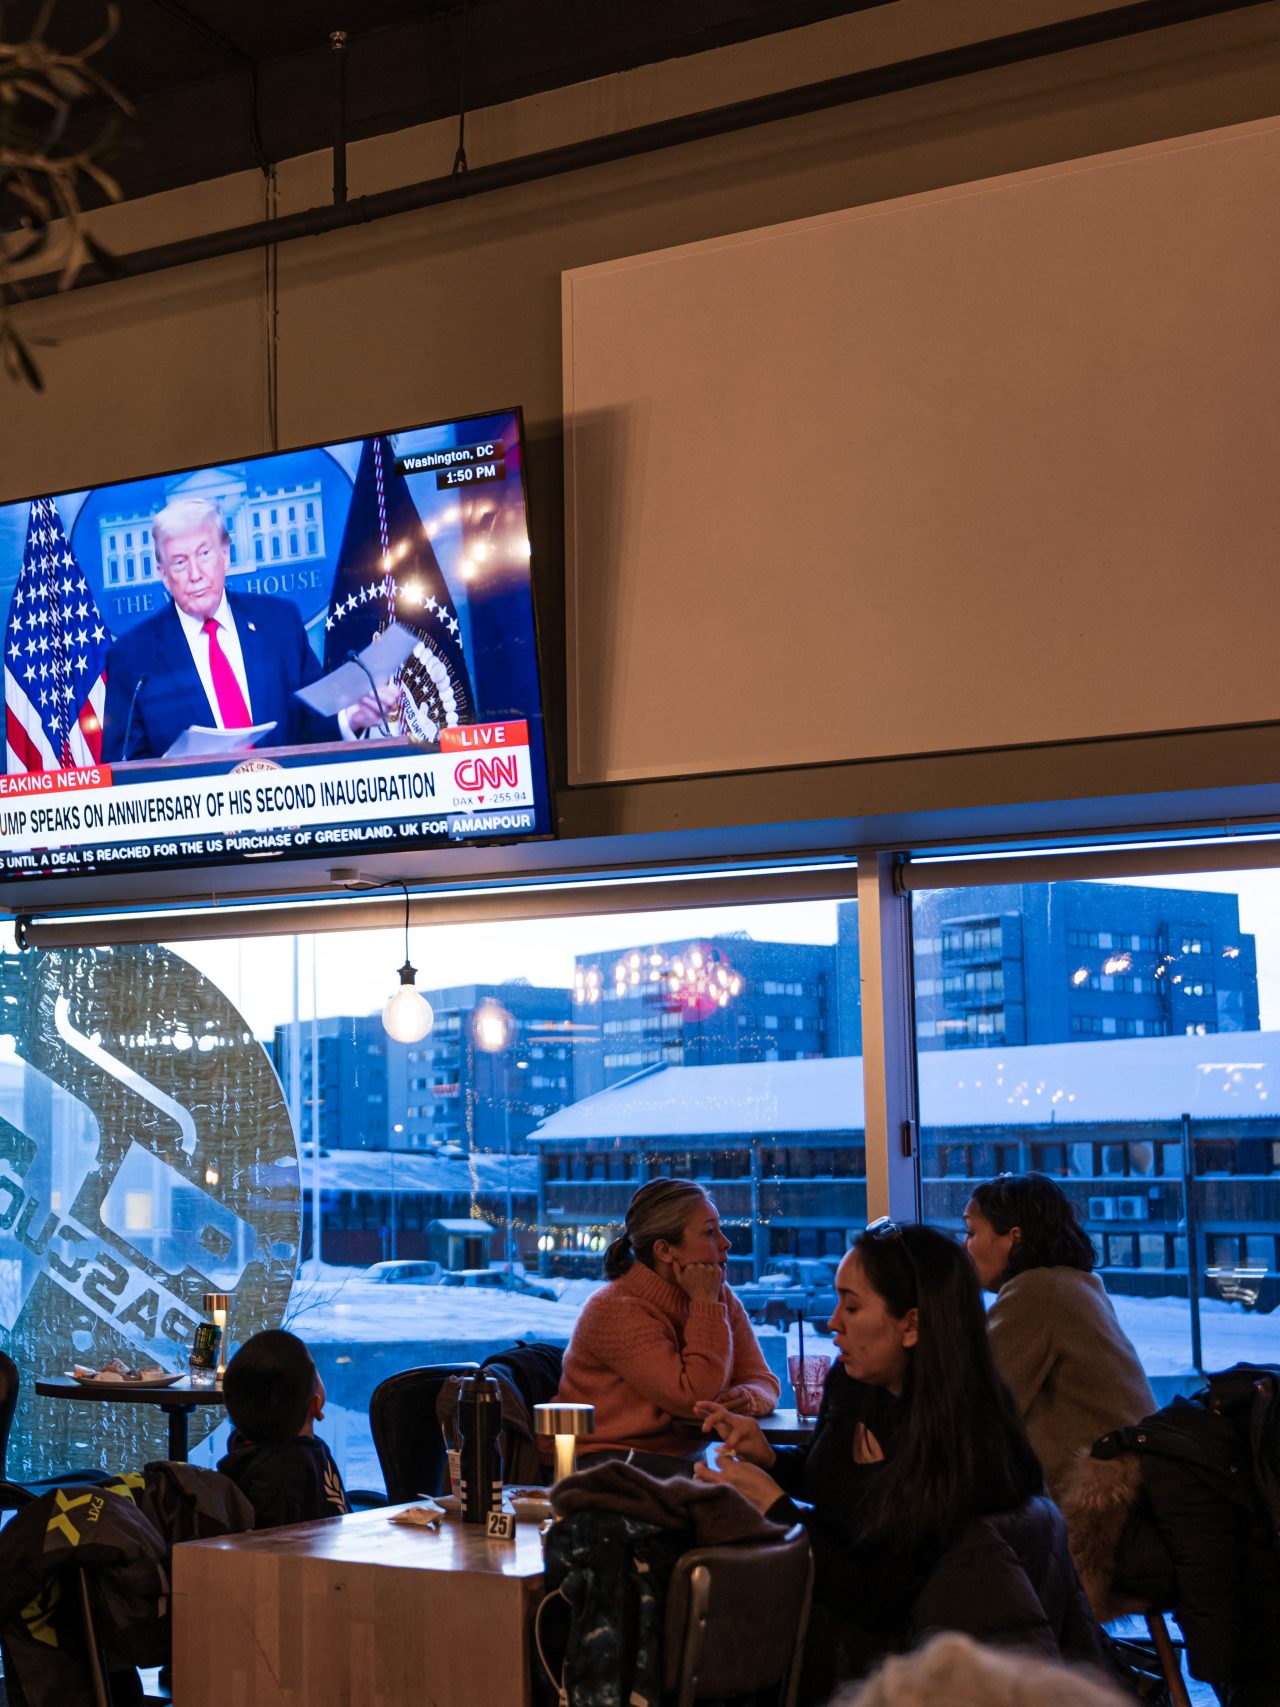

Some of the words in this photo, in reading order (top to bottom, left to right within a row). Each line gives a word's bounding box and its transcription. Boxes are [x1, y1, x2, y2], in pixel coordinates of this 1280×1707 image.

[404, 451, 473, 469] Washington,
[476, 445, 494, 457] DC
[446, 469, 473, 484] 1:50
[476, 464, 496, 478] PM
[113, 594, 155, 615] THE
[247, 570, 322, 595] HOUSE
[461, 726, 506, 746] LIVE
[57, 769, 101, 788] NEWS
[454, 754, 518, 791] CNN
[30, 805, 81, 833] SPEAKS
[84, 803, 104, 827] ON
[108, 794, 202, 826] ANNIVERSARY
[206, 792, 225, 817] OF
[228, 790, 252, 815] HIS
[256, 784, 316, 812] SECOND
[320, 772, 436, 807] INAUGURATION
[453, 797, 473, 806] DAX
[452, 814, 531, 833] AMANPOUR
[6, 855, 38, 868] UNTIL
[40, 854, 50, 866] A
[51, 852, 80, 866] DEAL
[83, 851, 94, 862] IS
[96, 846, 151, 861] REACHED
[153, 844, 178, 856] FOR
[180, 842, 204, 854] THE
[206, 840, 223, 852] US
[226, 833, 292, 851] PURCHASE
[294, 831, 312, 844] OF
[314, 826, 398, 843] GREENLAND.
[400, 822, 419, 836] UK
[422, 820, 448, 834] FOR
[87, 1496, 104, 1522] FXR
[489, 1514, 508, 1535] 25
